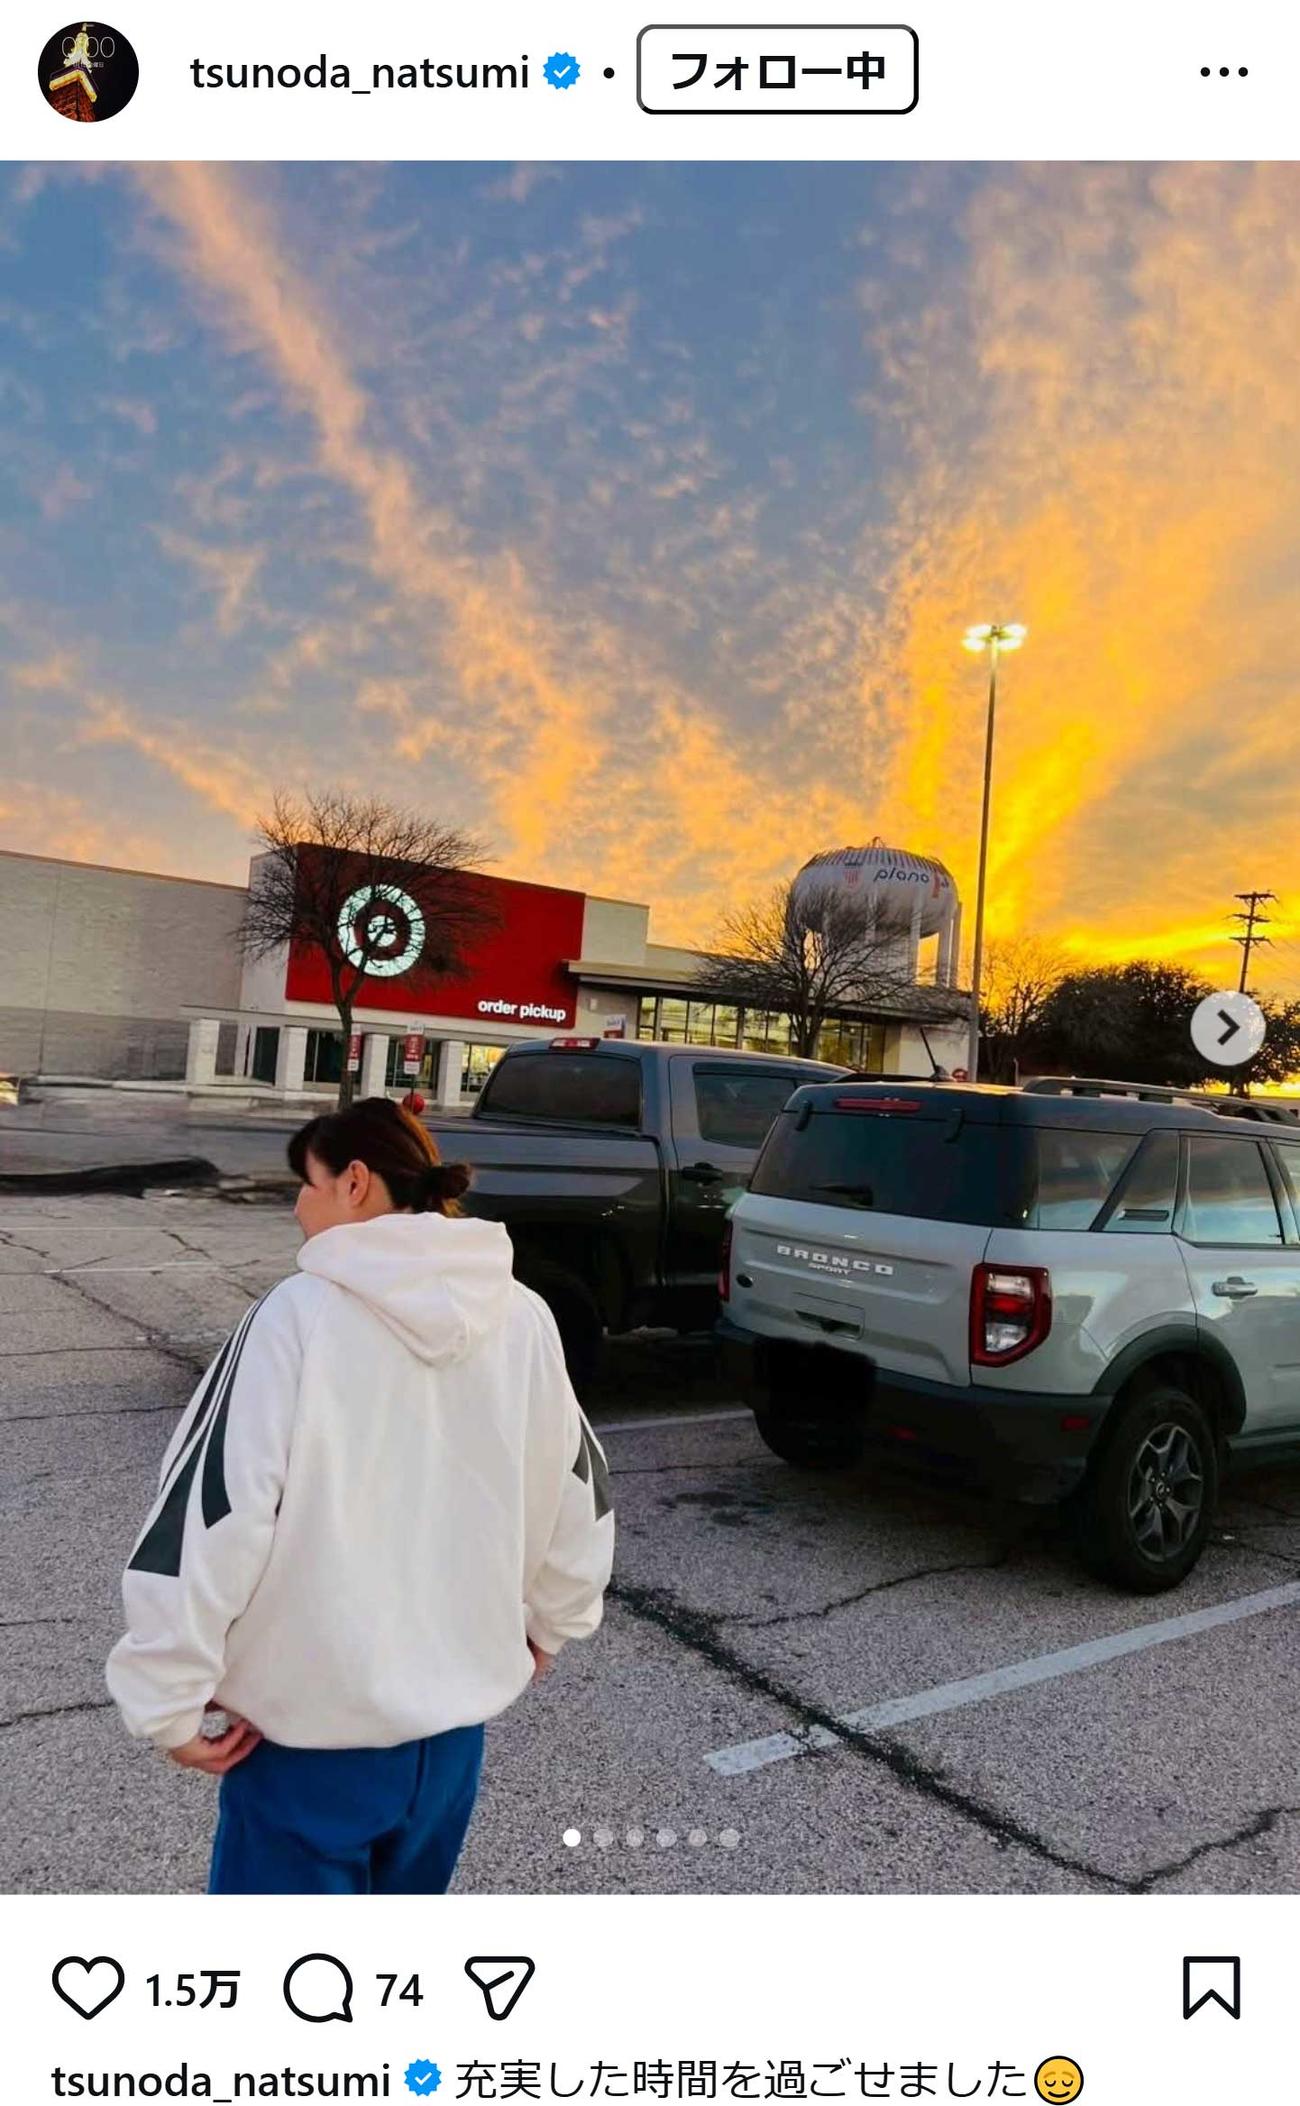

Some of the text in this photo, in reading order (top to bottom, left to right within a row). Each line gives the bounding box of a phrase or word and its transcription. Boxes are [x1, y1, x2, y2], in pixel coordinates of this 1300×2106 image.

[873, 867, 931, 884] plano
[477, 999, 567, 1022] order pickup
[776, 1245, 894, 1276] BRONCO
